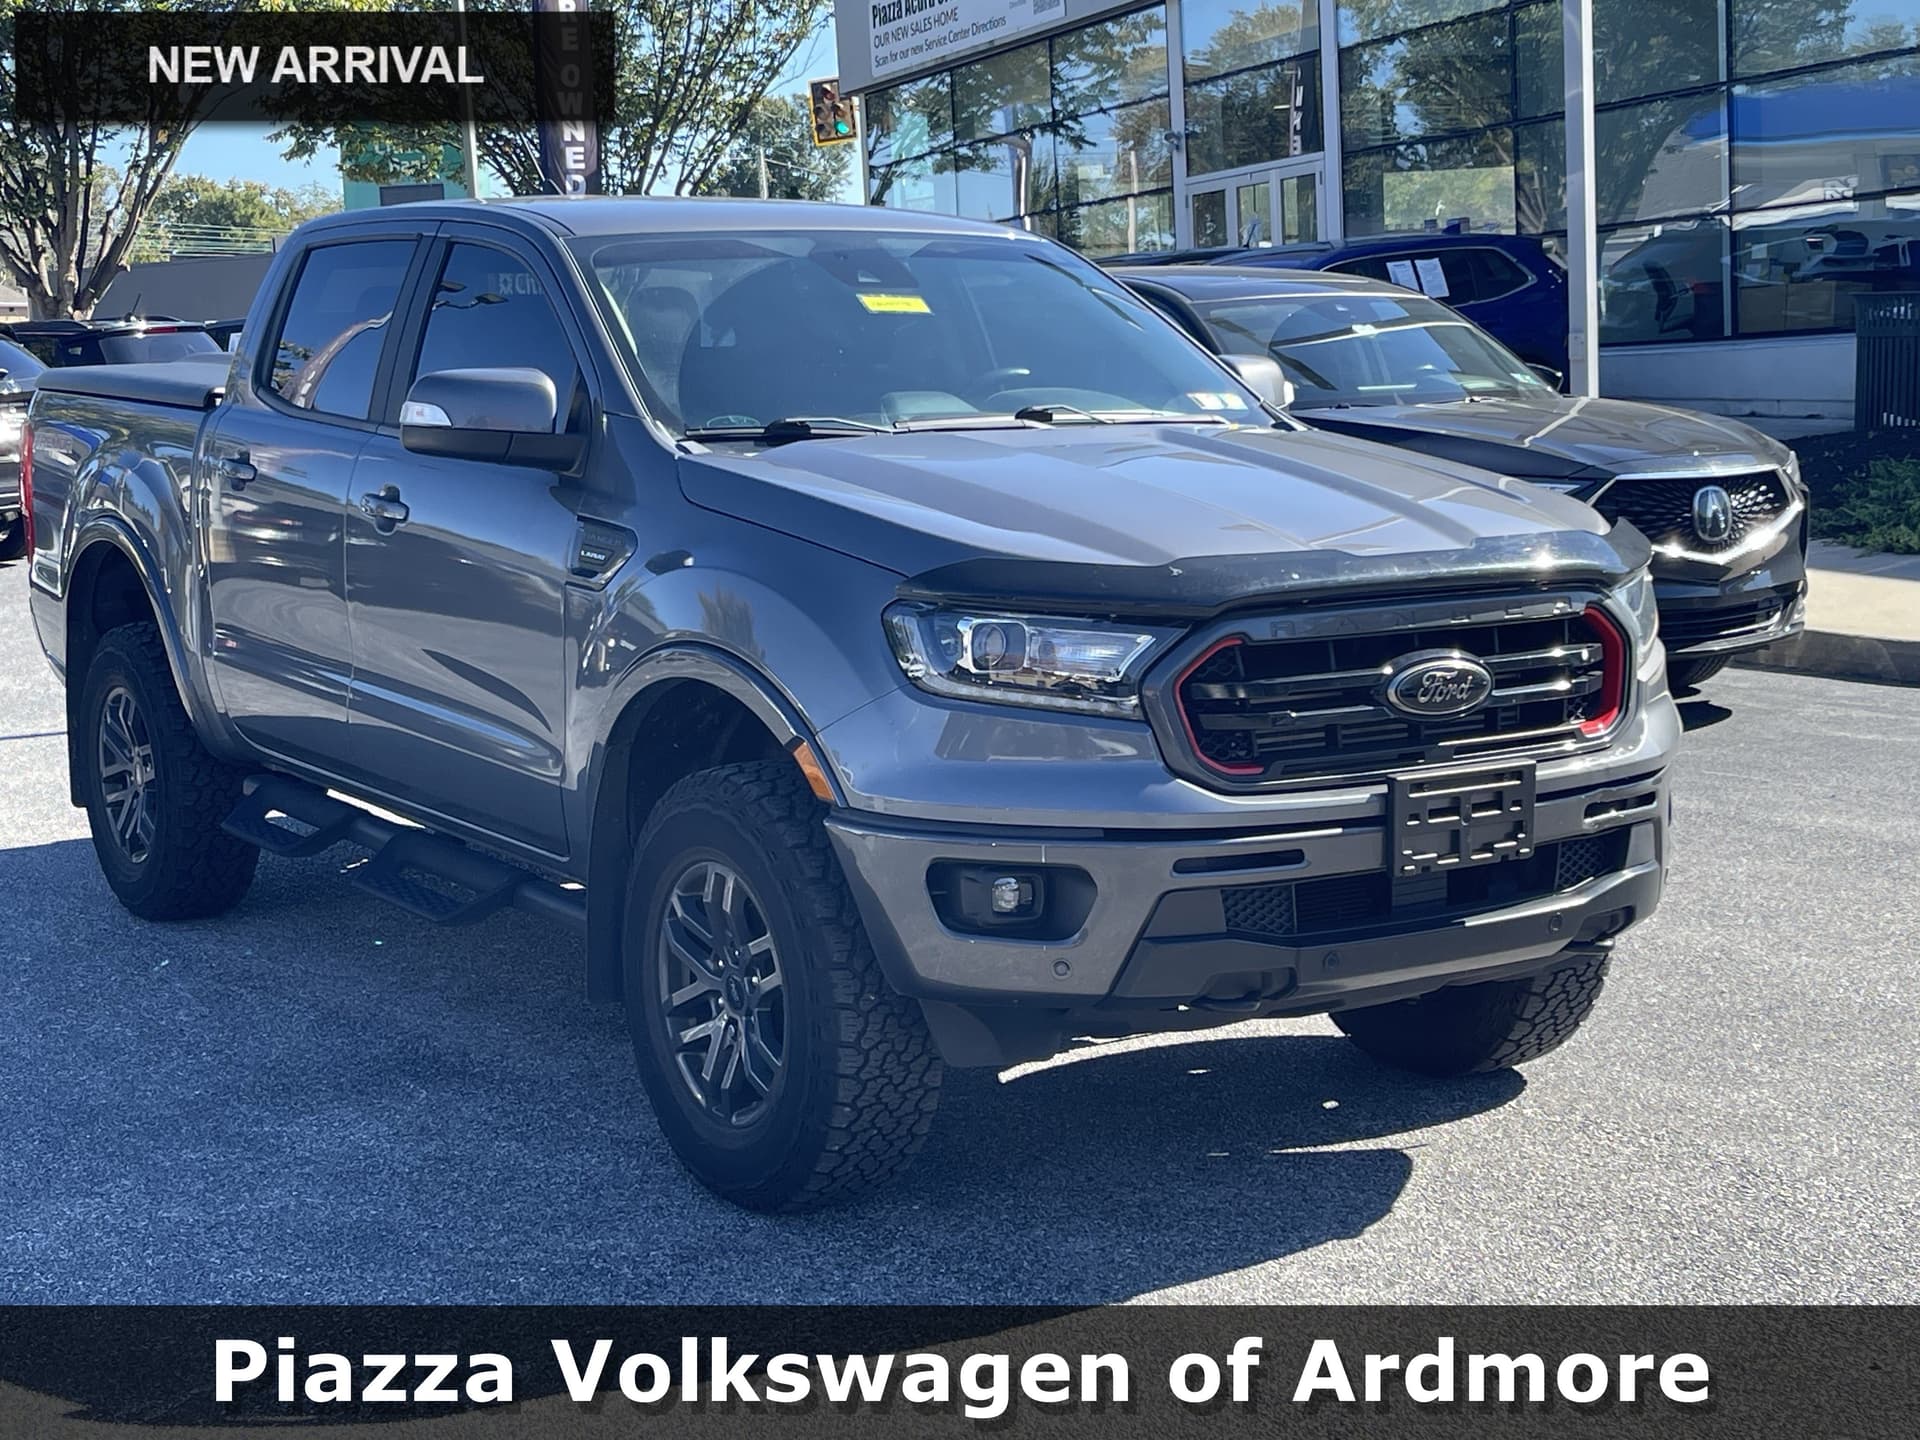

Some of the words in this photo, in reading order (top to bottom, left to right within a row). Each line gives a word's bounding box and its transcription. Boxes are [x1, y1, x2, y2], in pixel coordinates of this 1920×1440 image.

[872, 0, 903, 29] Piazza
[873, 31, 890, 49] OUR
[891, 24, 909, 44] NEW
[910, 16, 933, 37] SALES
[933, 7, 959, 29] HOME
[874, 54, 890, 69] Scan
[889, 50, 899, 62] for
[900, 47, 910, 59] our
[911, 43, 924, 56] new
[924, 34, 947, 52] Service
[947, 27, 970, 44] Center
[970, 15, 1007, 36] Directions
[1417, 671, 1473, 703] Ford
